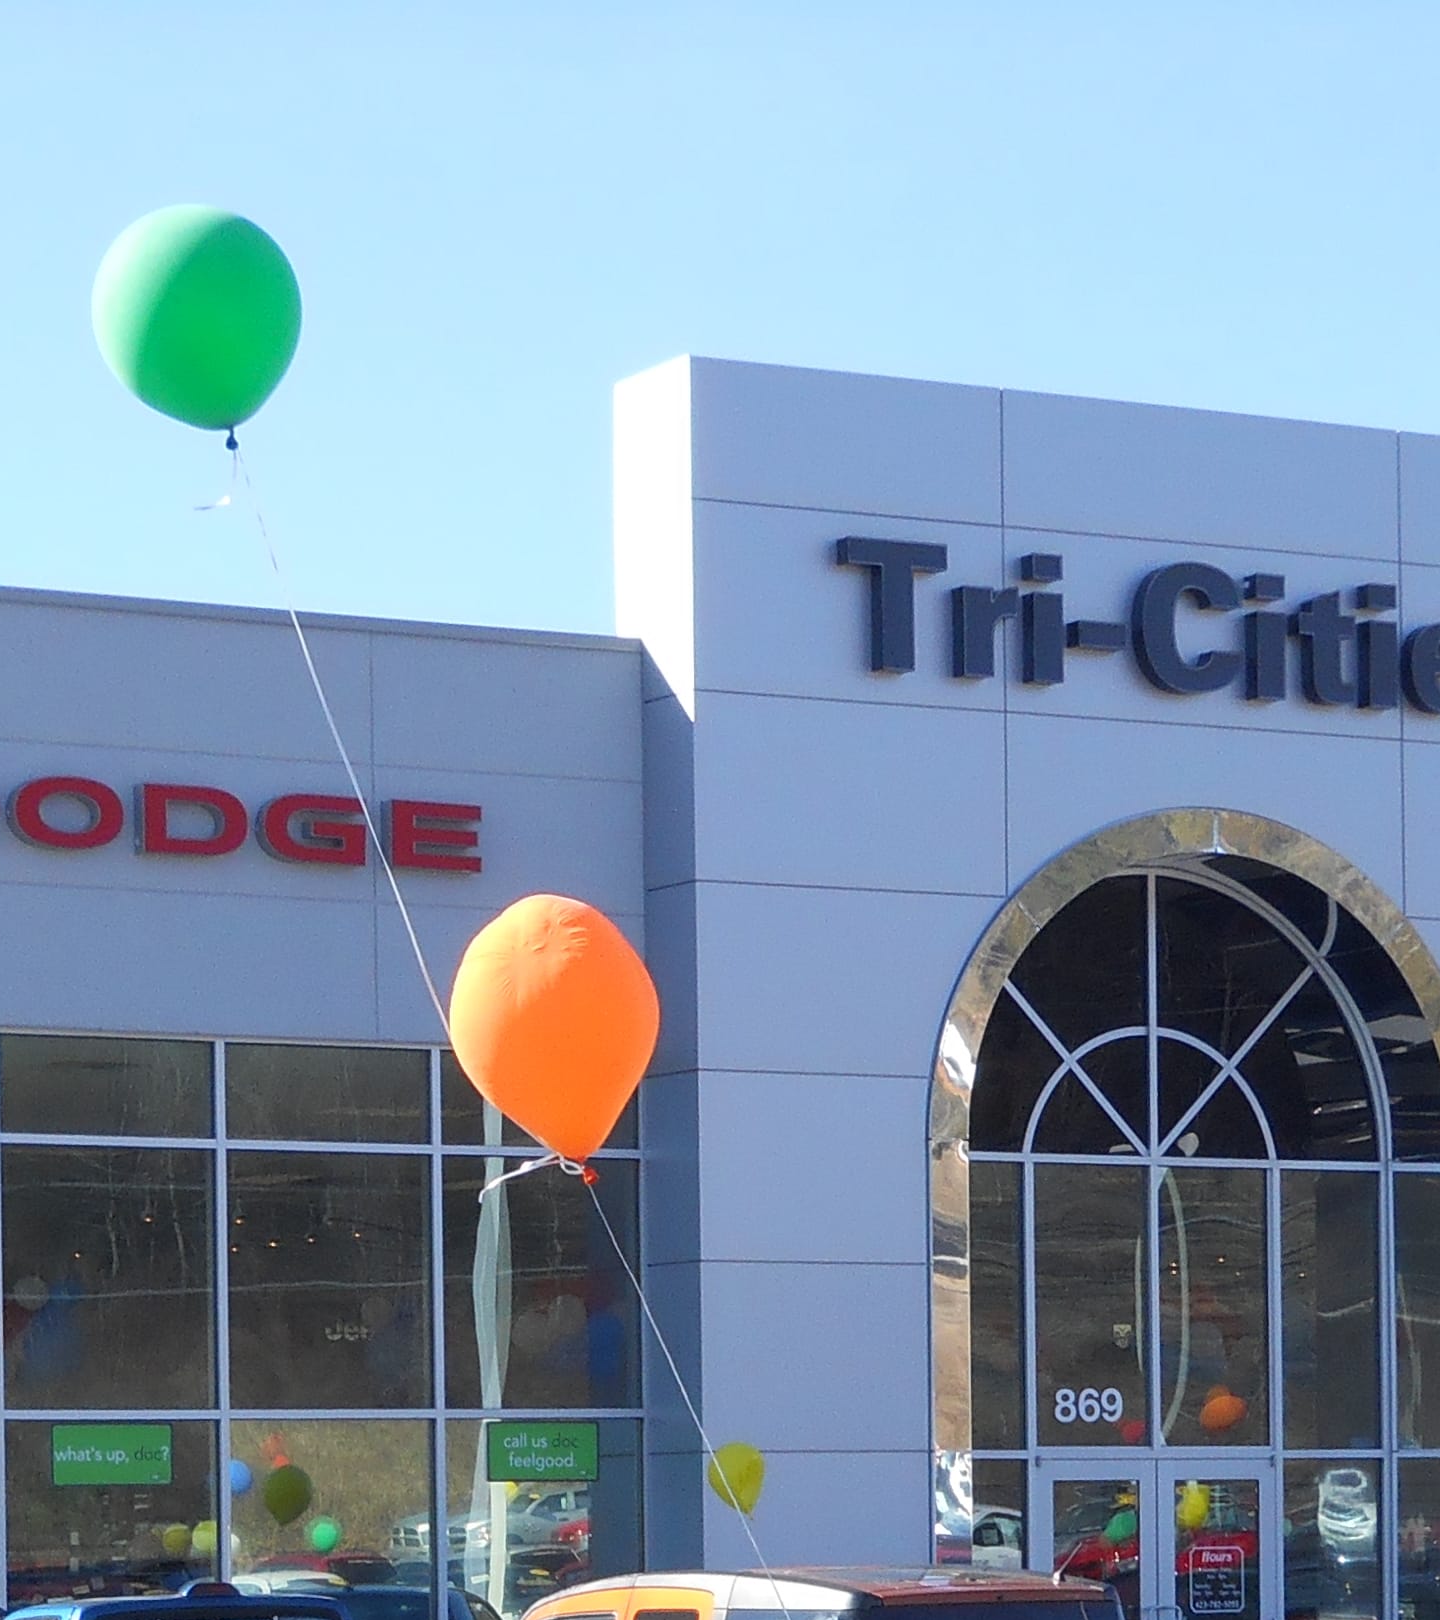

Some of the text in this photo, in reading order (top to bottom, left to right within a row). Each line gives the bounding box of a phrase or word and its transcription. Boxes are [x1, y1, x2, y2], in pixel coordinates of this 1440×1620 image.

[1054, 1388, 1123, 1423] 869
[503, 1432, 578, 1448] call us doc
[54, 1446, 102, 1461] what's
[509, 1451, 577, 1471] feelgood.
[1201, 1551, 1233, 1562] Hours
